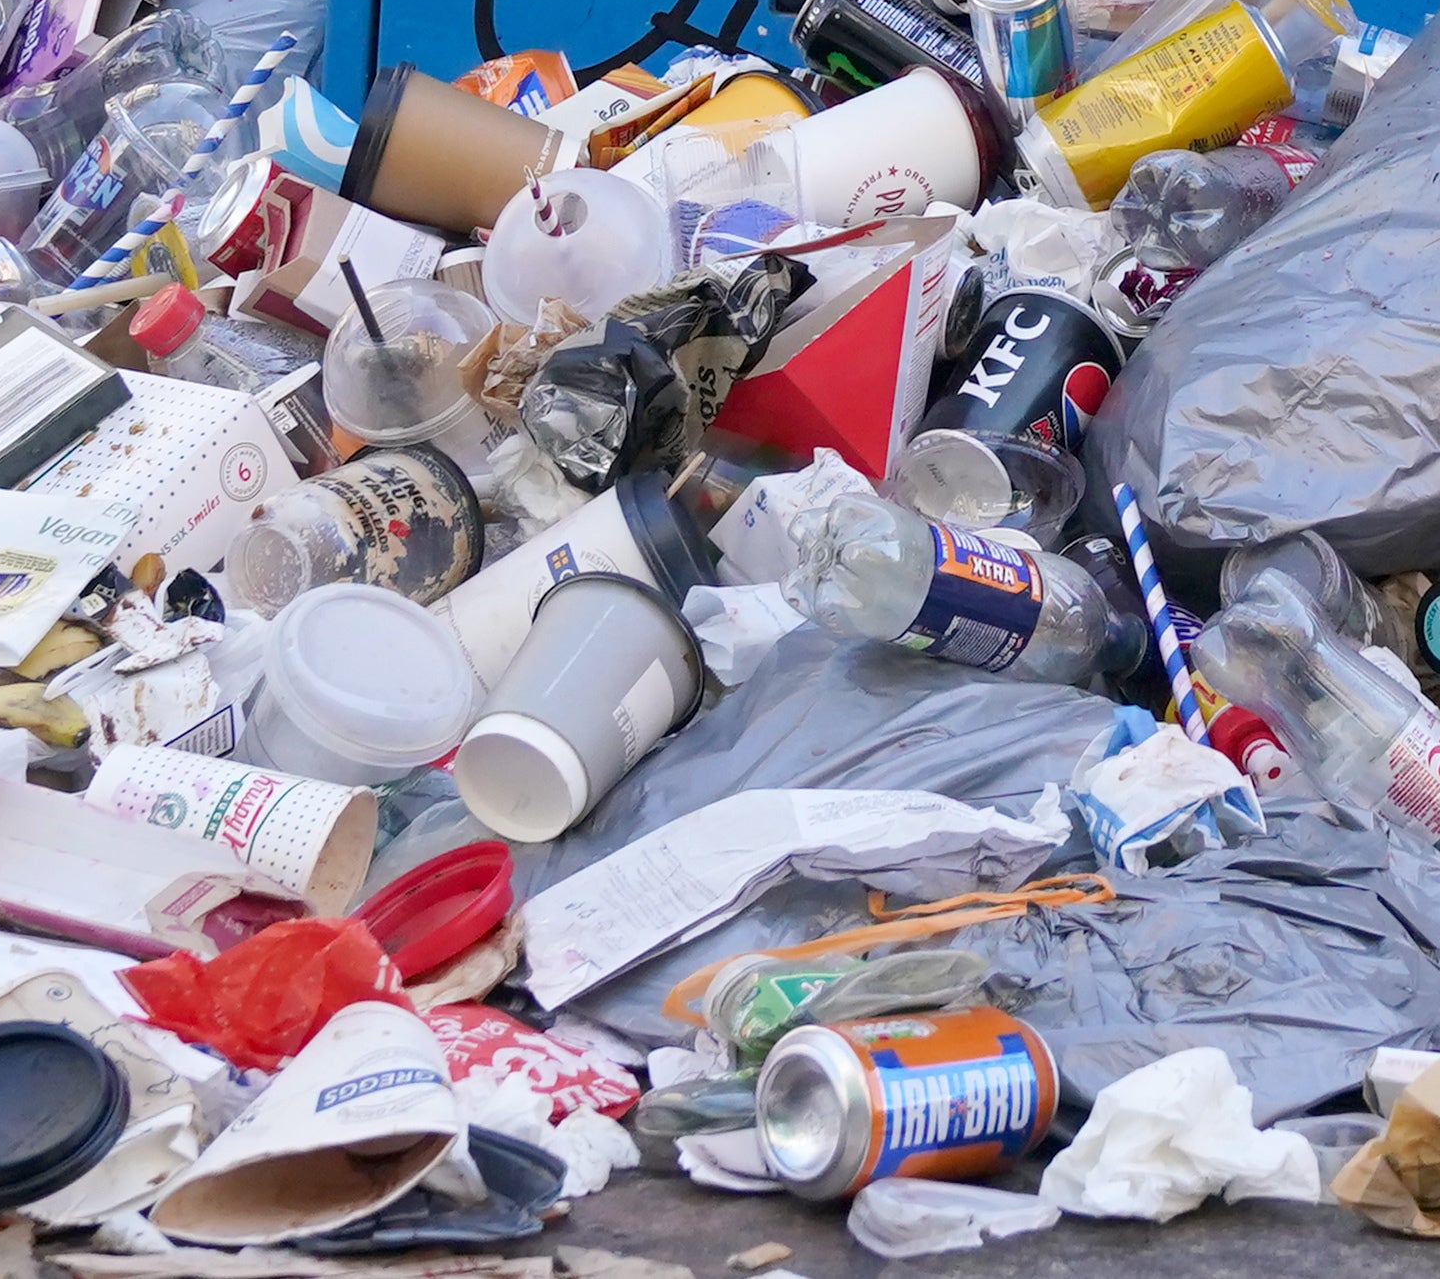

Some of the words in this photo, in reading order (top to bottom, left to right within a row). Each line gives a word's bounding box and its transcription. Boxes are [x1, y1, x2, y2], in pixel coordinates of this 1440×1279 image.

[845, 168, 883, 215] FRESHLY
[958, 303, 1051, 410] KFC
[236, 461, 253, 484] 6
[170, 524, 191, 548] SIX
[186, 491, 222, 534] Smiles
[361, 476, 394, 520] TANG
[38, 514, 118, 549] Vegan
[970, 553, 1016, 586] XTRA
[321, 1068, 438, 1108] GREGGS
[889, 1071, 952, 1151] IRN
[964, 1061, 1032, 1140] BRU
